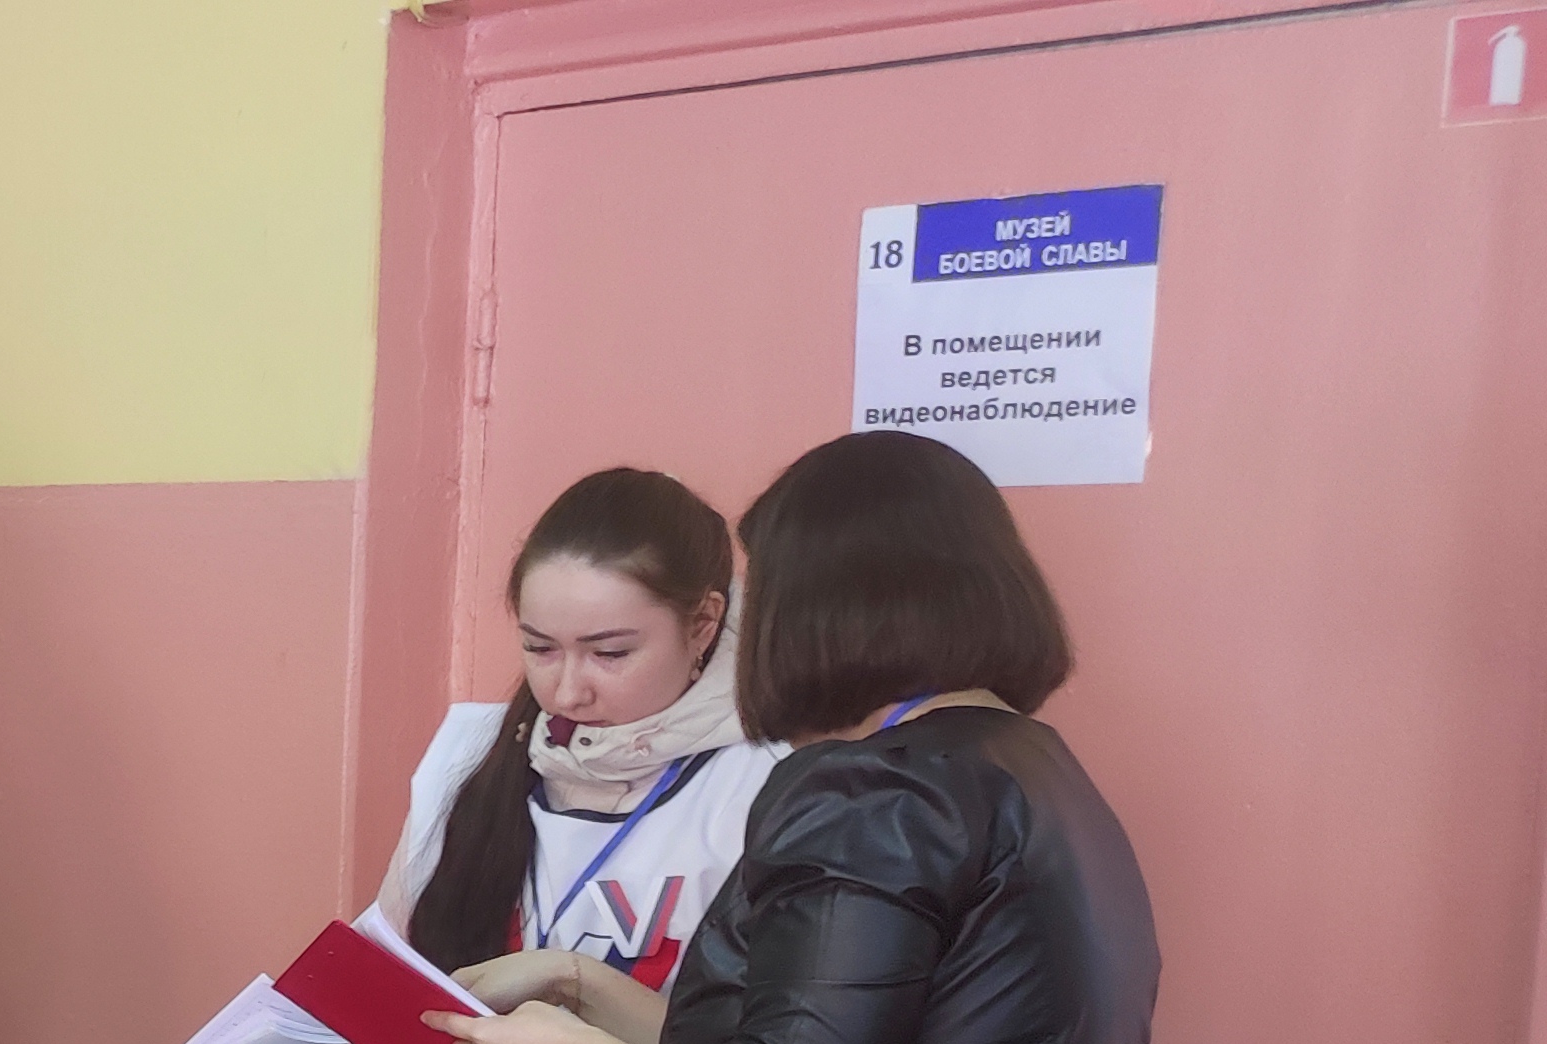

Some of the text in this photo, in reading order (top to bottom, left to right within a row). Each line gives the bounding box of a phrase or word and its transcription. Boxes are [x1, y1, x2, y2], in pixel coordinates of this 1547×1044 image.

[995, 210, 1071, 242] МУЗЕЙ
[868, 240, 903, 269] 18
[938, 239, 1127, 275] БОЕВОЙ СЛАВЫ
[903, 328, 1102, 356] В помещении
[940, 366, 1056, 390] ведется
[864, 396, 1137, 427] видеонаблюдение
